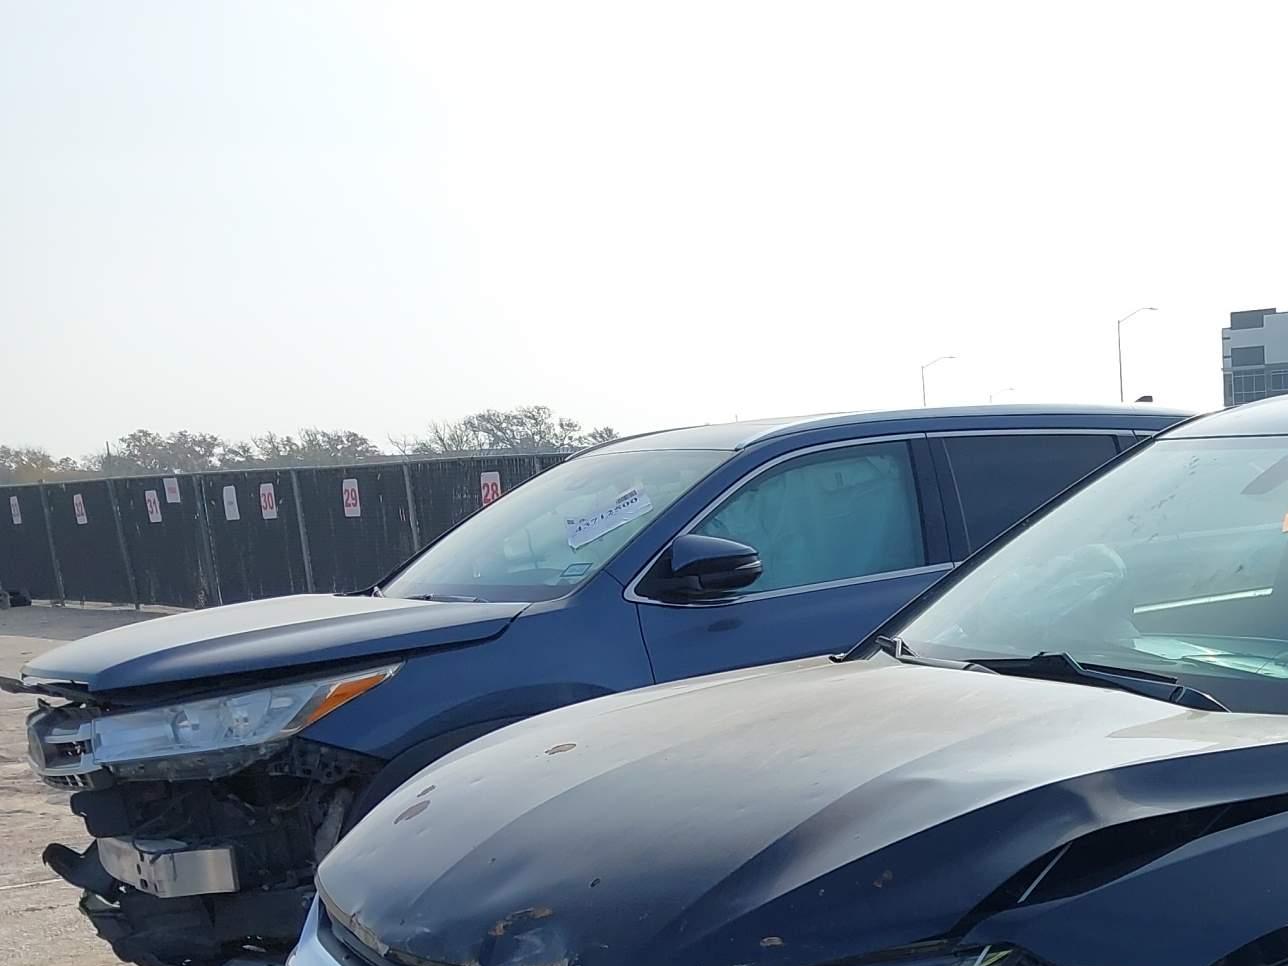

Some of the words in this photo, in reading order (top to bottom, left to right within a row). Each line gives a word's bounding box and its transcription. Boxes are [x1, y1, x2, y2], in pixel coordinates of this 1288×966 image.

[261, 492, 274, 510] 30
[343, 488, 358, 508] 29
[481, 482, 500, 505] 28
[147, 499, 160, 515] 31
